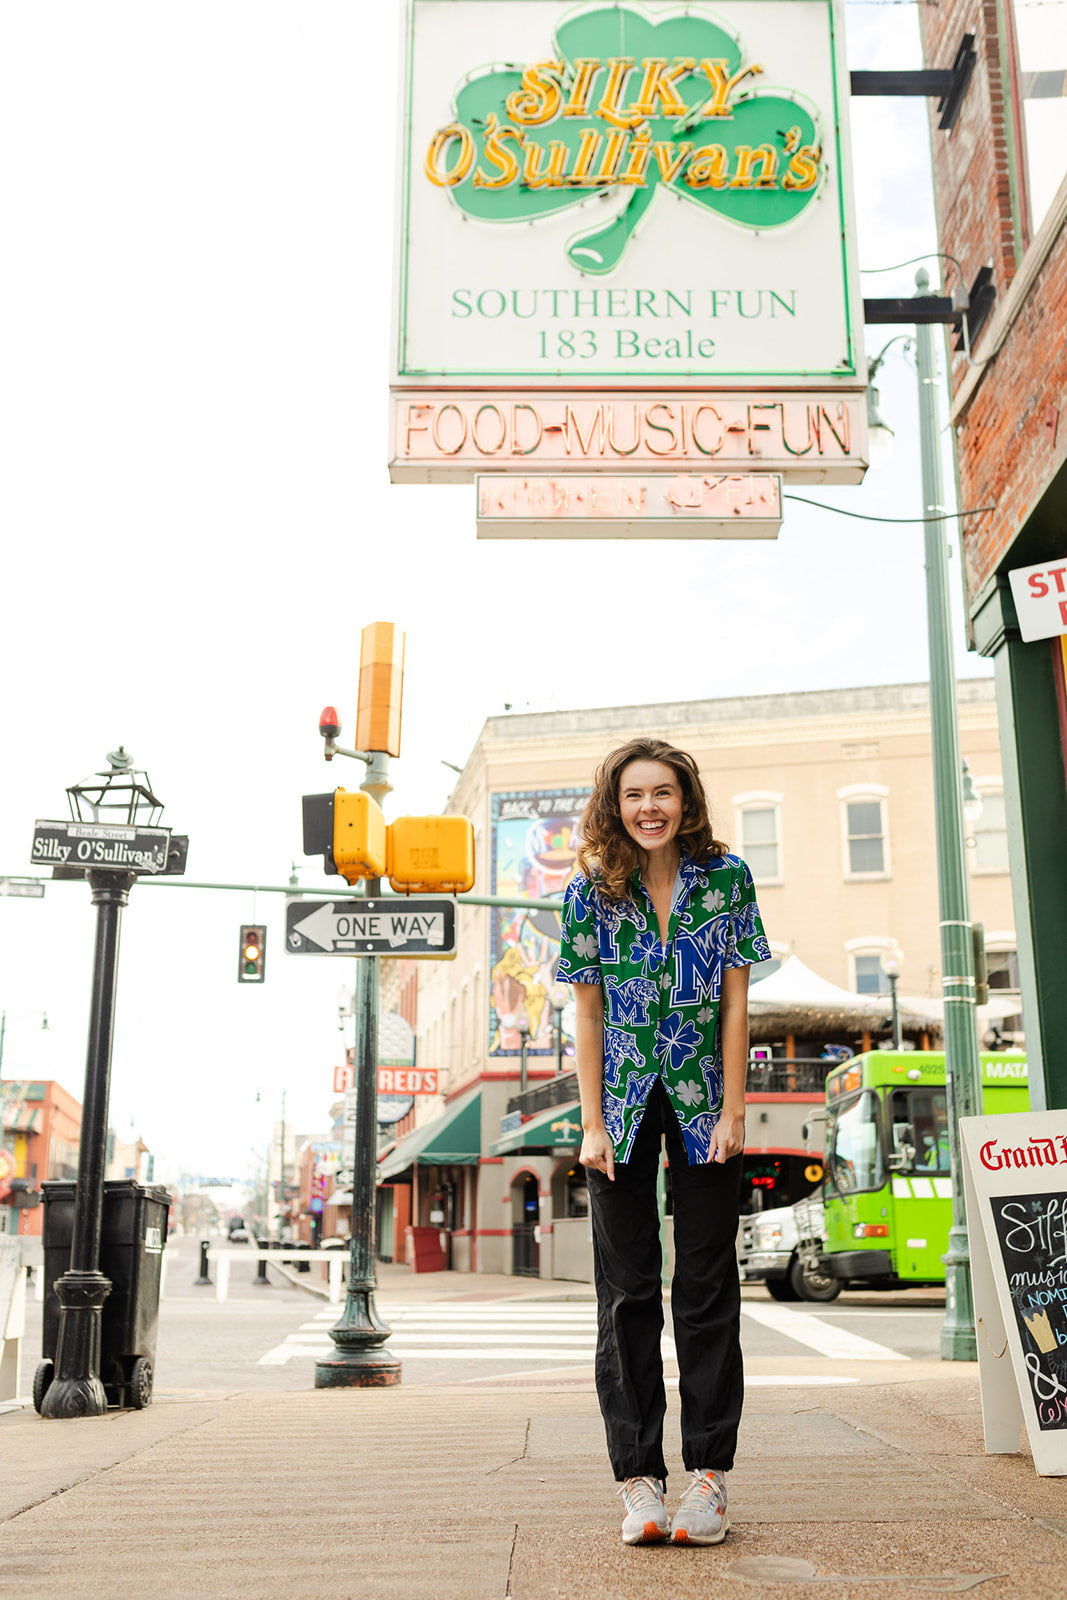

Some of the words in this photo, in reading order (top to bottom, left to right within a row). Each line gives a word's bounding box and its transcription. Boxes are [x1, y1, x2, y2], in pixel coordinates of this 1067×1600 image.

[505, 56, 765, 129] SILKY
[424, 113, 822, 191] O'Sullivan's
[451, 288, 693, 319] SOUTHERN
[709, 288, 799, 319] FUN
[537, 328, 599, 359] 183
[613, 328, 717, 359] Beale
[482, 478, 645, 512] KITCHEN
[667, 474, 776, 509] OPEN
[1028, 567, 1067, 598] ST
[75, 828, 99, 839] Beale
[102, 829, 128, 840] Street
[33, 837, 72, 861] Silky
[77, 839, 164, 865] O'Sullivan's
[336, 917, 381, 937] ONE
[391, 916, 437, 937] WAY
[606, 986, 650, 1027] M
[335, 1067, 437, 1092] ARED'S
